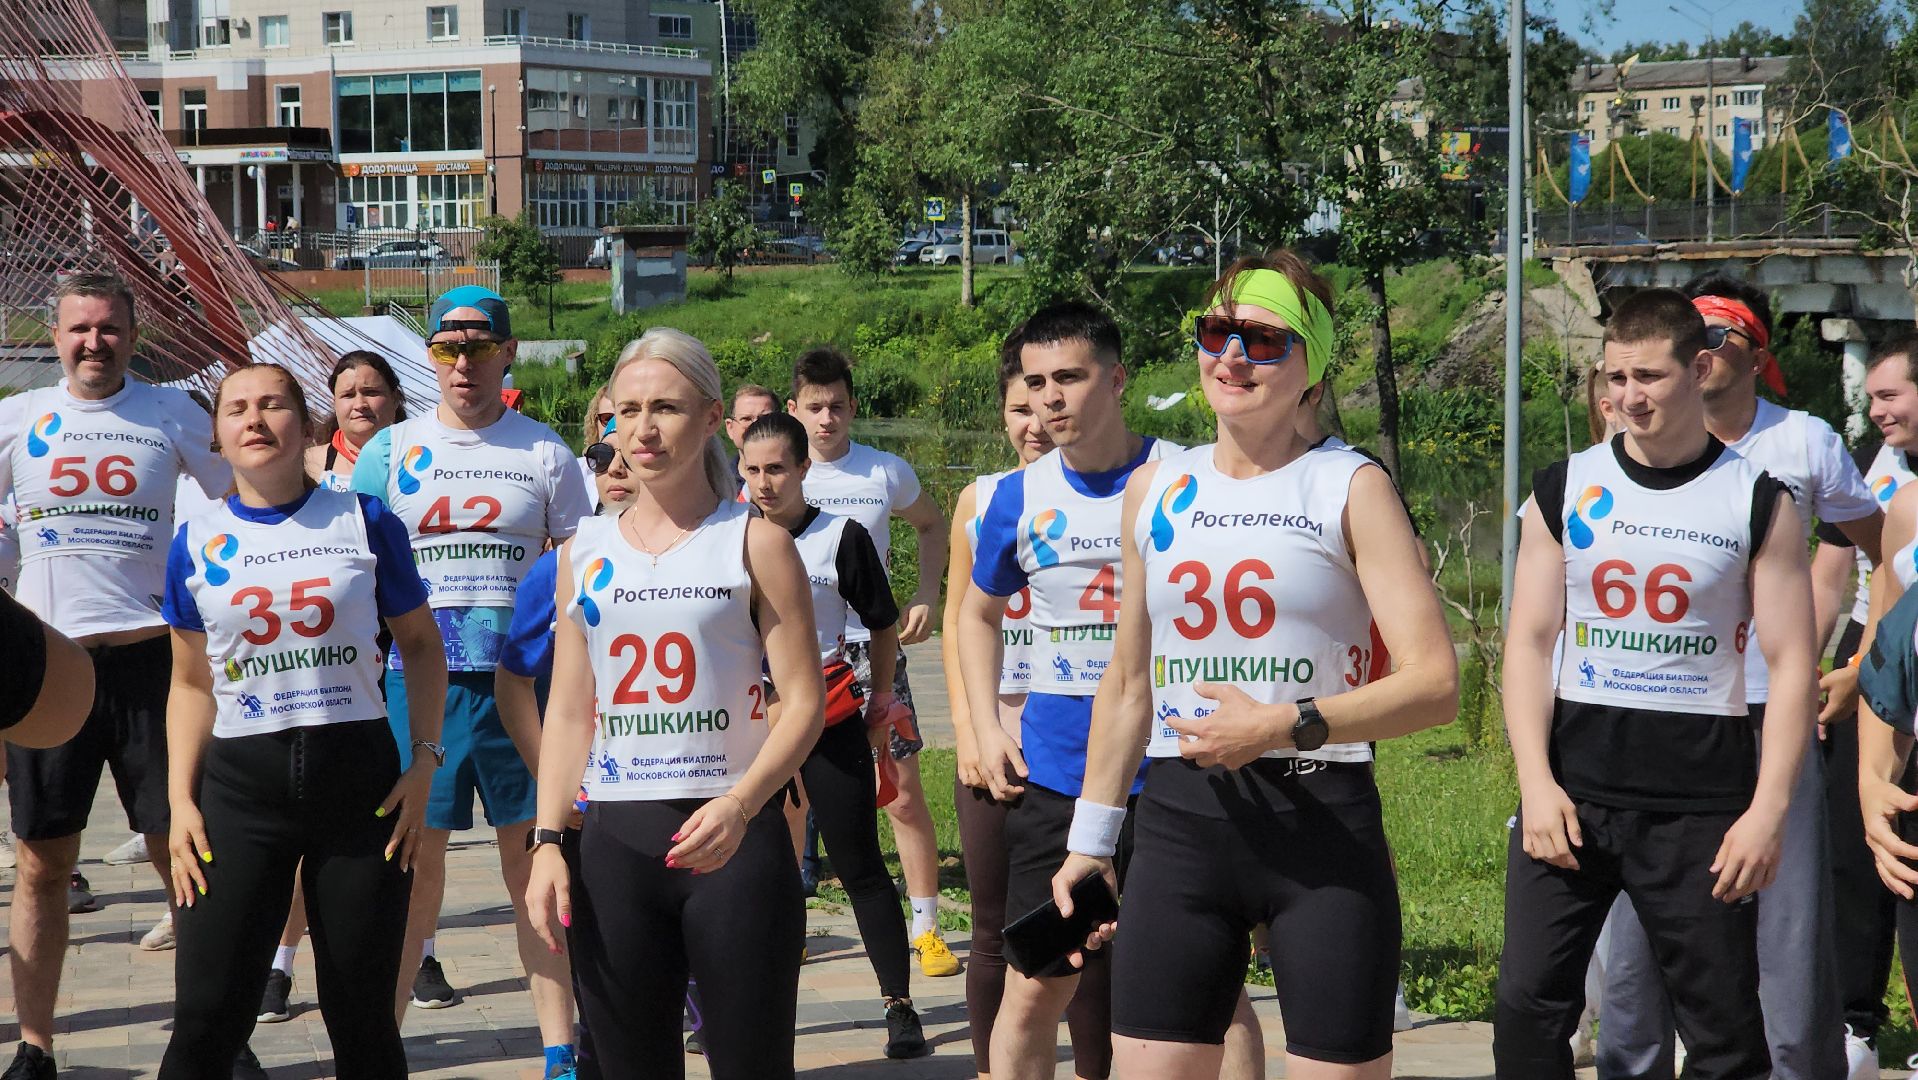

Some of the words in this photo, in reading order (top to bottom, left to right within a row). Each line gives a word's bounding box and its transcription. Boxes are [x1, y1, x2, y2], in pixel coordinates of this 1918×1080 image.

[361, 164, 385, 174] ДОДО
[387, 164, 418, 174] ПИЦЦА
[436, 162, 470, 172] ДОСТАВКА
[544, 162, 563, 170] ДОДО
[564, 162, 586, 172] ПИЦЦА
[655, 165, 672, 174] ДОДО
[672, 166, 694, 174] ПИЦЦА
[63, 432, 165, 450] Ростелеком
[49, 455, 137, 497] 56
[434, 468, 534, 482] Ростелеком
[418, 495, 502, 534] 42
[1190, 510, 1322, 536] Ростелеком
[1612, 520, 1739, 552] Ростелеком
[244, 546, 360, 568] Ростелеком
[420, 543, 526, 564] ПУШКИНО
[613, 586, 732, 604] Ростелеком
[1167, 558, 1276, 641] 36
[1592, 559, 1692, 624] 66
[230, 577, 334, 646] 35
[1592, 628, 1717, 656] ПУШКИНО
[242, 646, 358, 678] ПУШКИНО
[609, 631, 696, 706] 29
[1169, 656, 1314, 684] ПУШКИНО
[608, 708, 730, 738] ПУШКИНО
[632, 757, 680, 767] ФЕДЕРАЦИЯ
[683, 754, 728, 764] БИАТЛОНА
[626, 768, 686, 780] МОСКОВСКОЙ
[688, 768, 728, 778] ОБЛАСТИ
